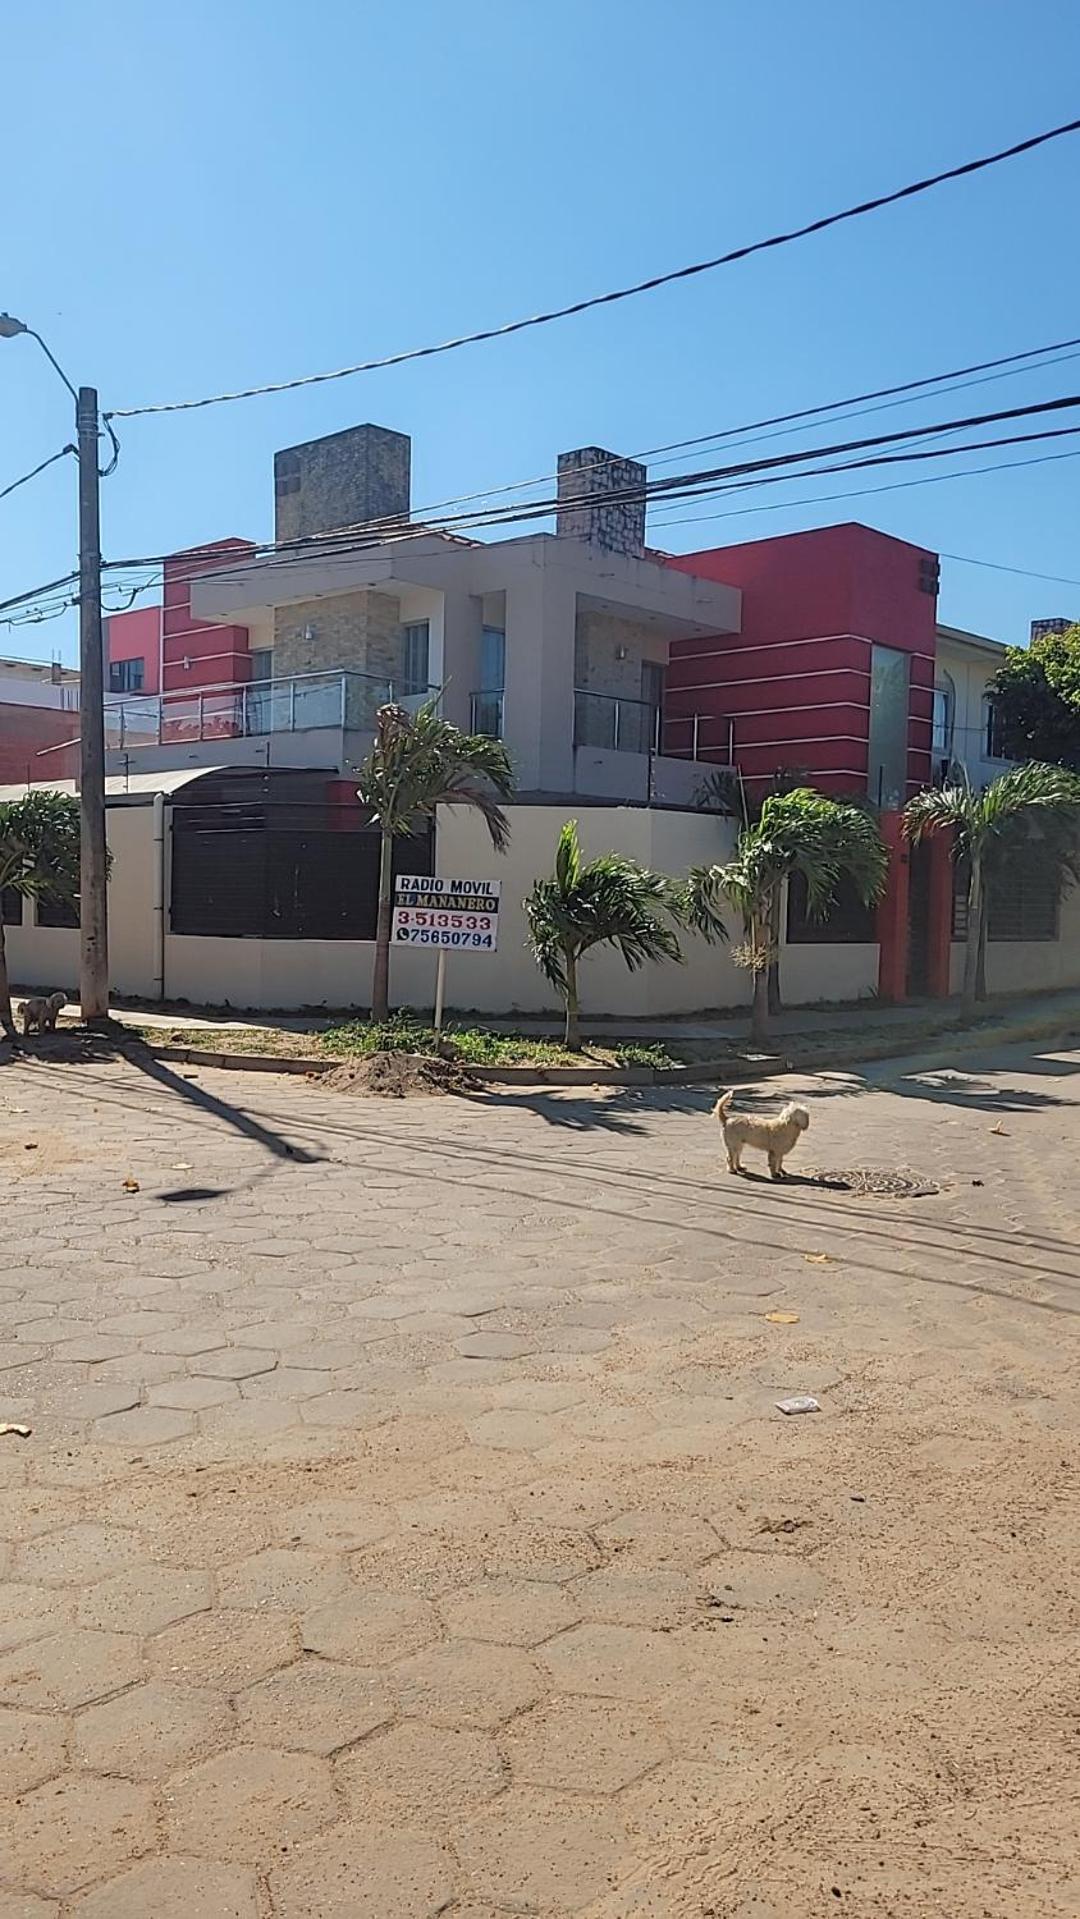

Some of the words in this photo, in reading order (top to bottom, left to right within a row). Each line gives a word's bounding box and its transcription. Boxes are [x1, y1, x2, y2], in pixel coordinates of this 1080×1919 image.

[400, 877, 444, 892] RADIO
[450, 880, 493, 895] MOVIL
[397, 894, 414, 906] EL
[410, 929, 492, 948] 75650794
